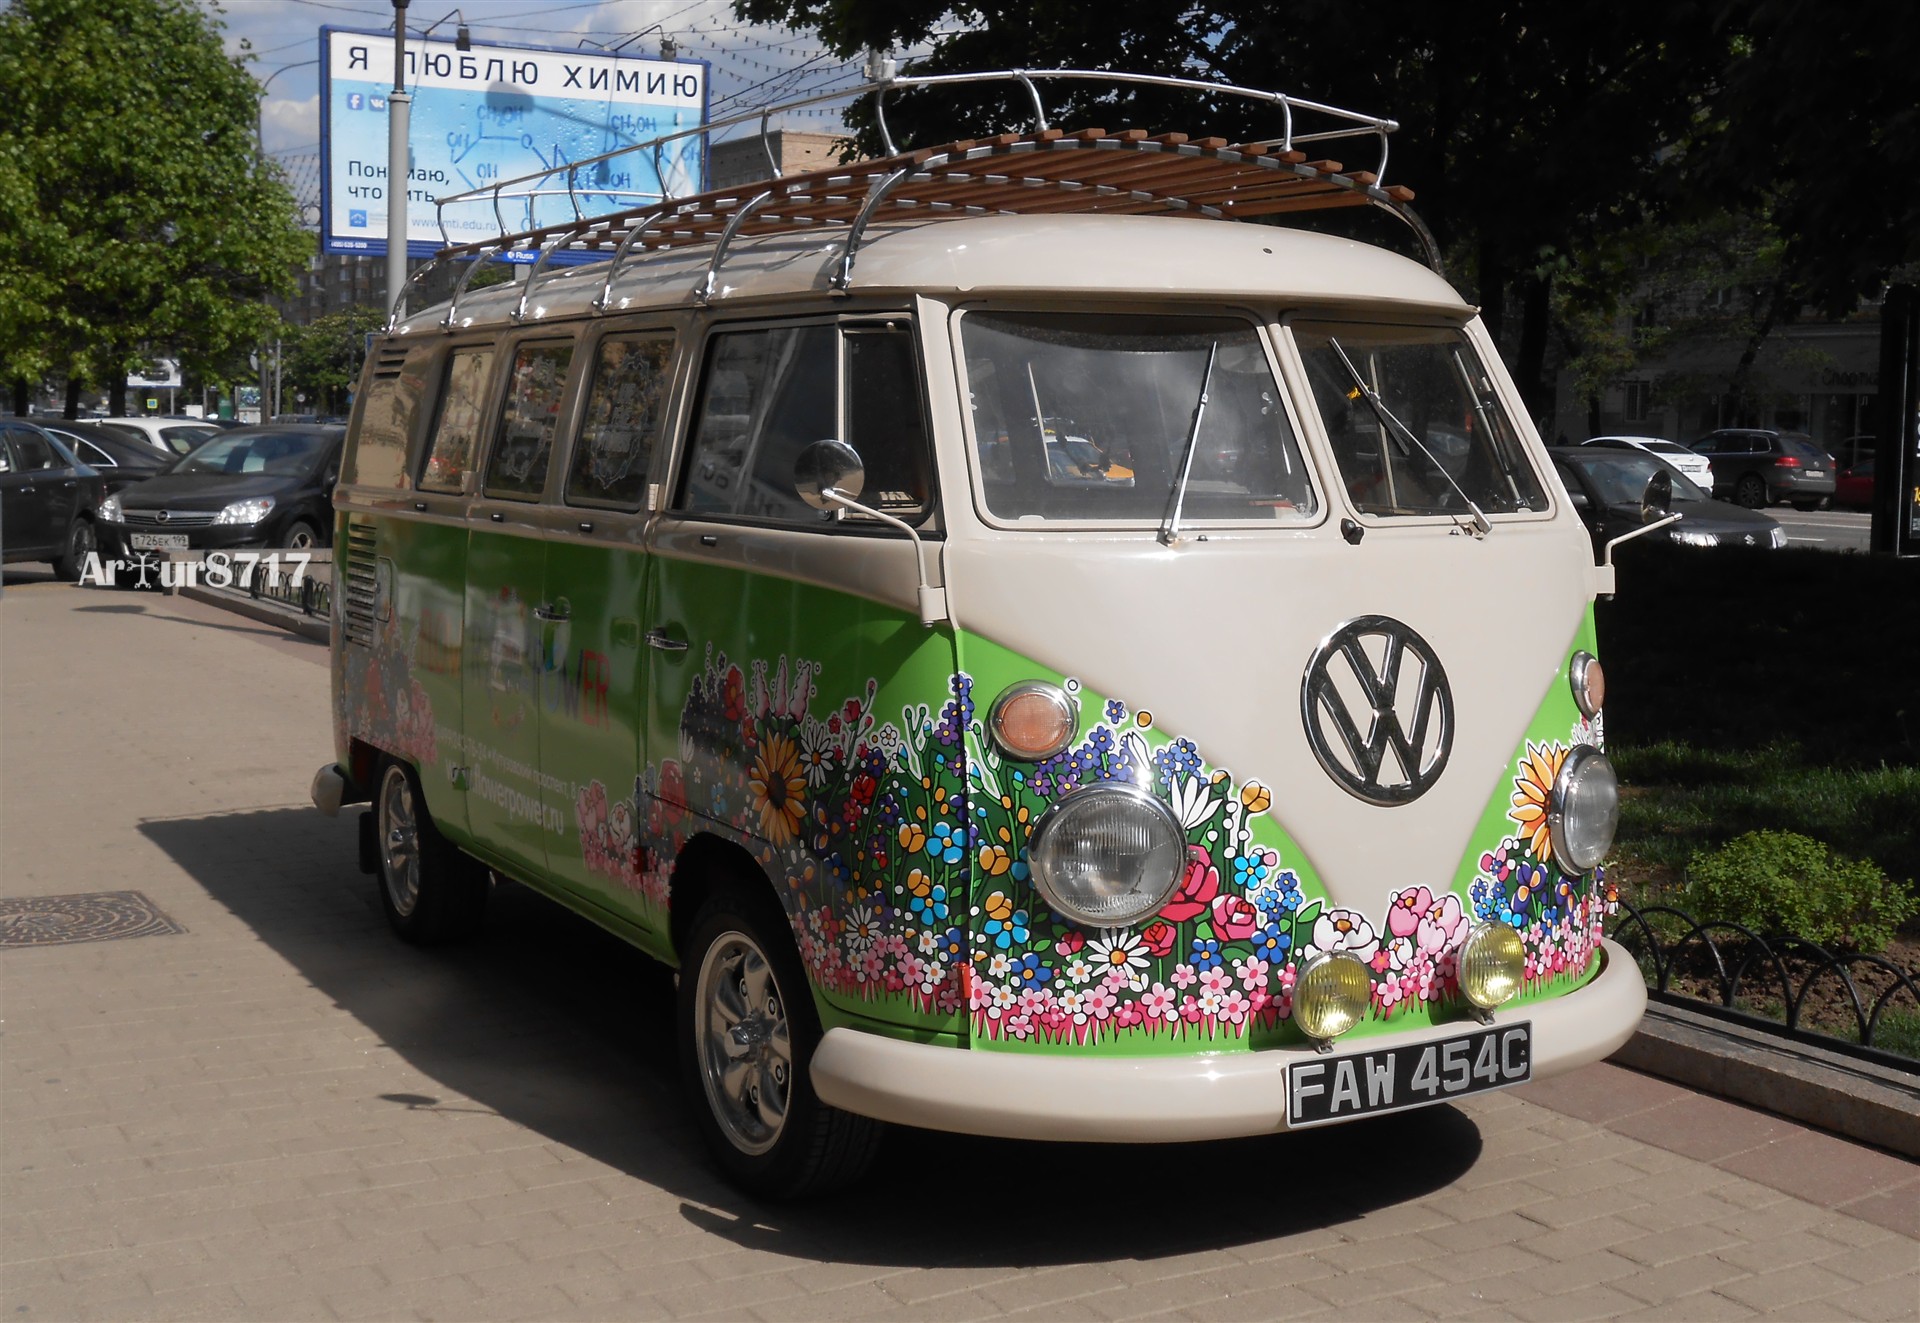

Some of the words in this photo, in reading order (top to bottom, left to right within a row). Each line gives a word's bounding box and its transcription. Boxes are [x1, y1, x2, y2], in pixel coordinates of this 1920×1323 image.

[348, 46, 368, 70] Я
[563, 65, 698, 98] ХИМИЮ
[348, 160, 450, 186] Понмаю,
[348, 186, 383, 200] что
[411, 218, 497, 232] wwwmti.edu.ru
[1292, 1053, 1396, 1119] FAW
[1411, 1028, 1528, 1096] 454C
